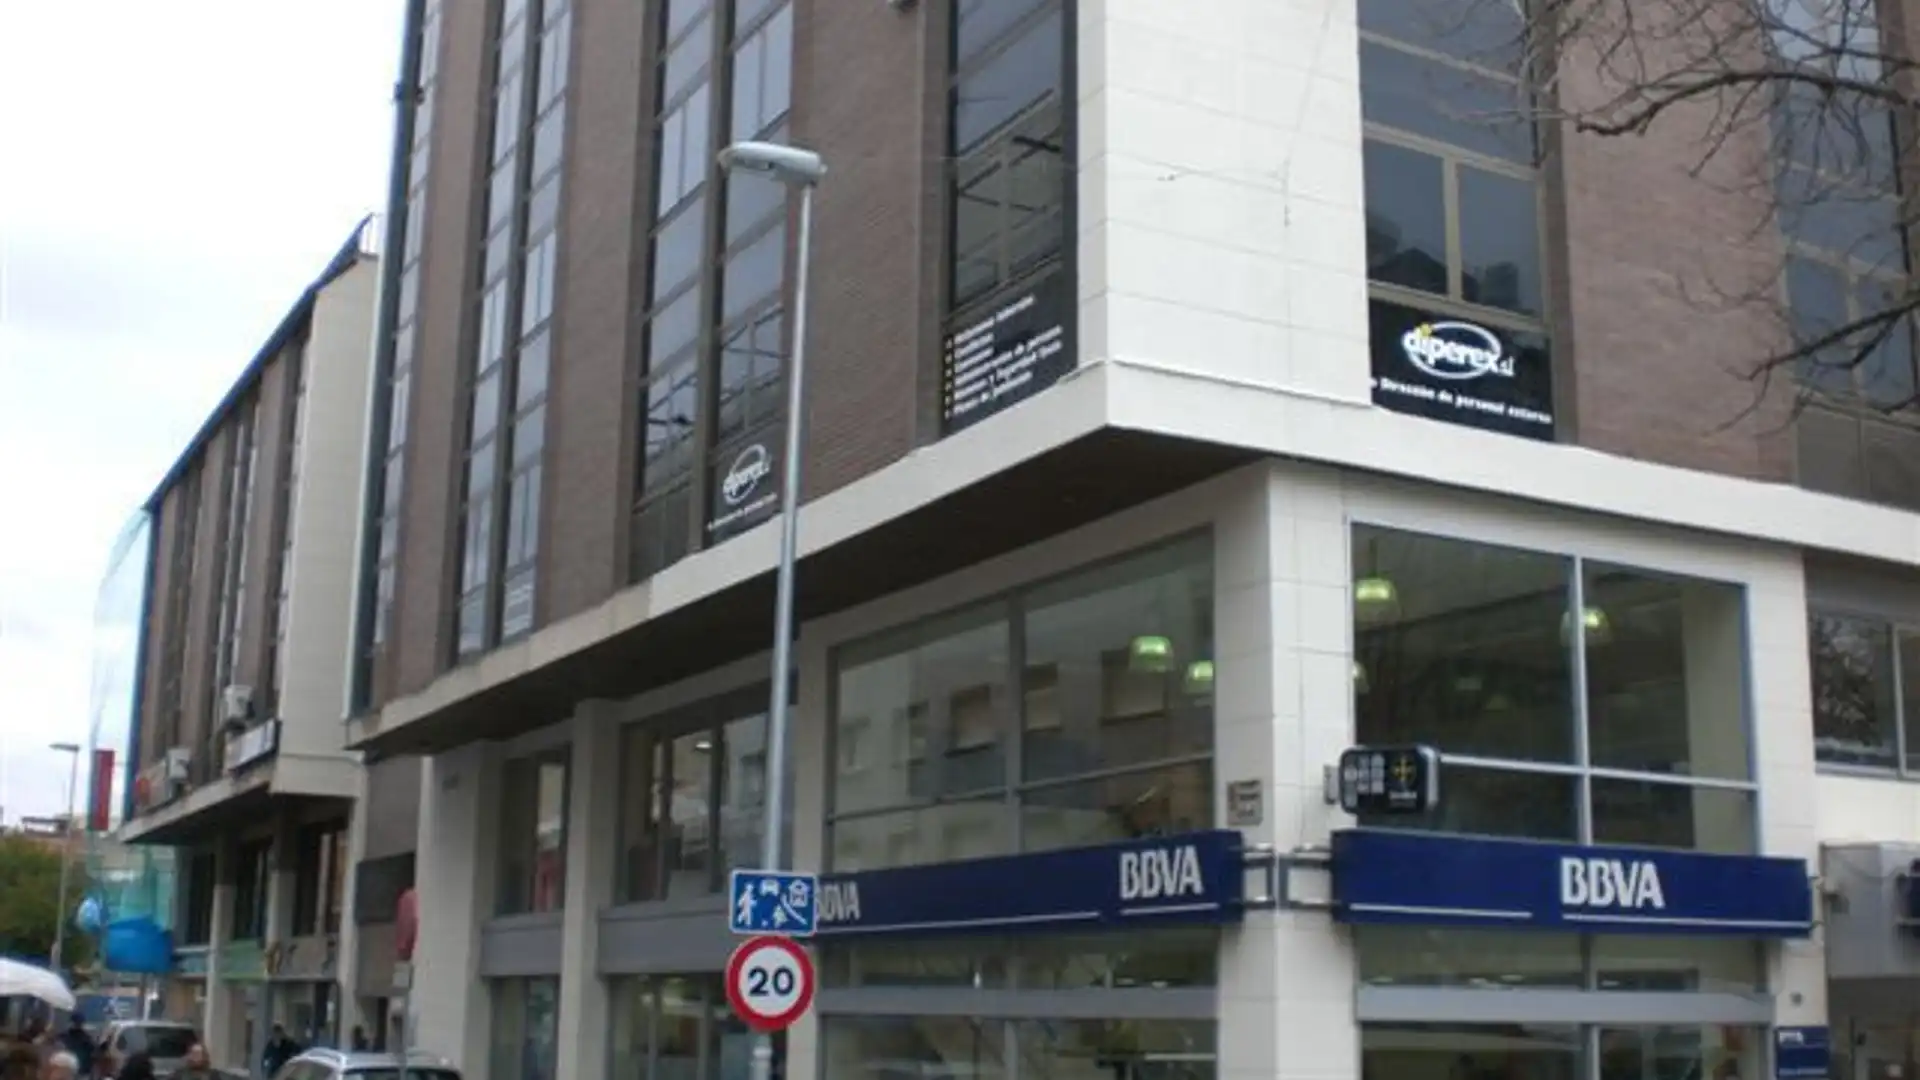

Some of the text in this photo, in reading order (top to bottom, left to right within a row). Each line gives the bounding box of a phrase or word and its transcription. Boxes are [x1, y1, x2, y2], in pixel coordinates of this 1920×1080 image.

[1119, 843, 1205, 900] BBVA
[1561, 856, 1666, 909] BBVA
[748, 966, 795, 997] 20
